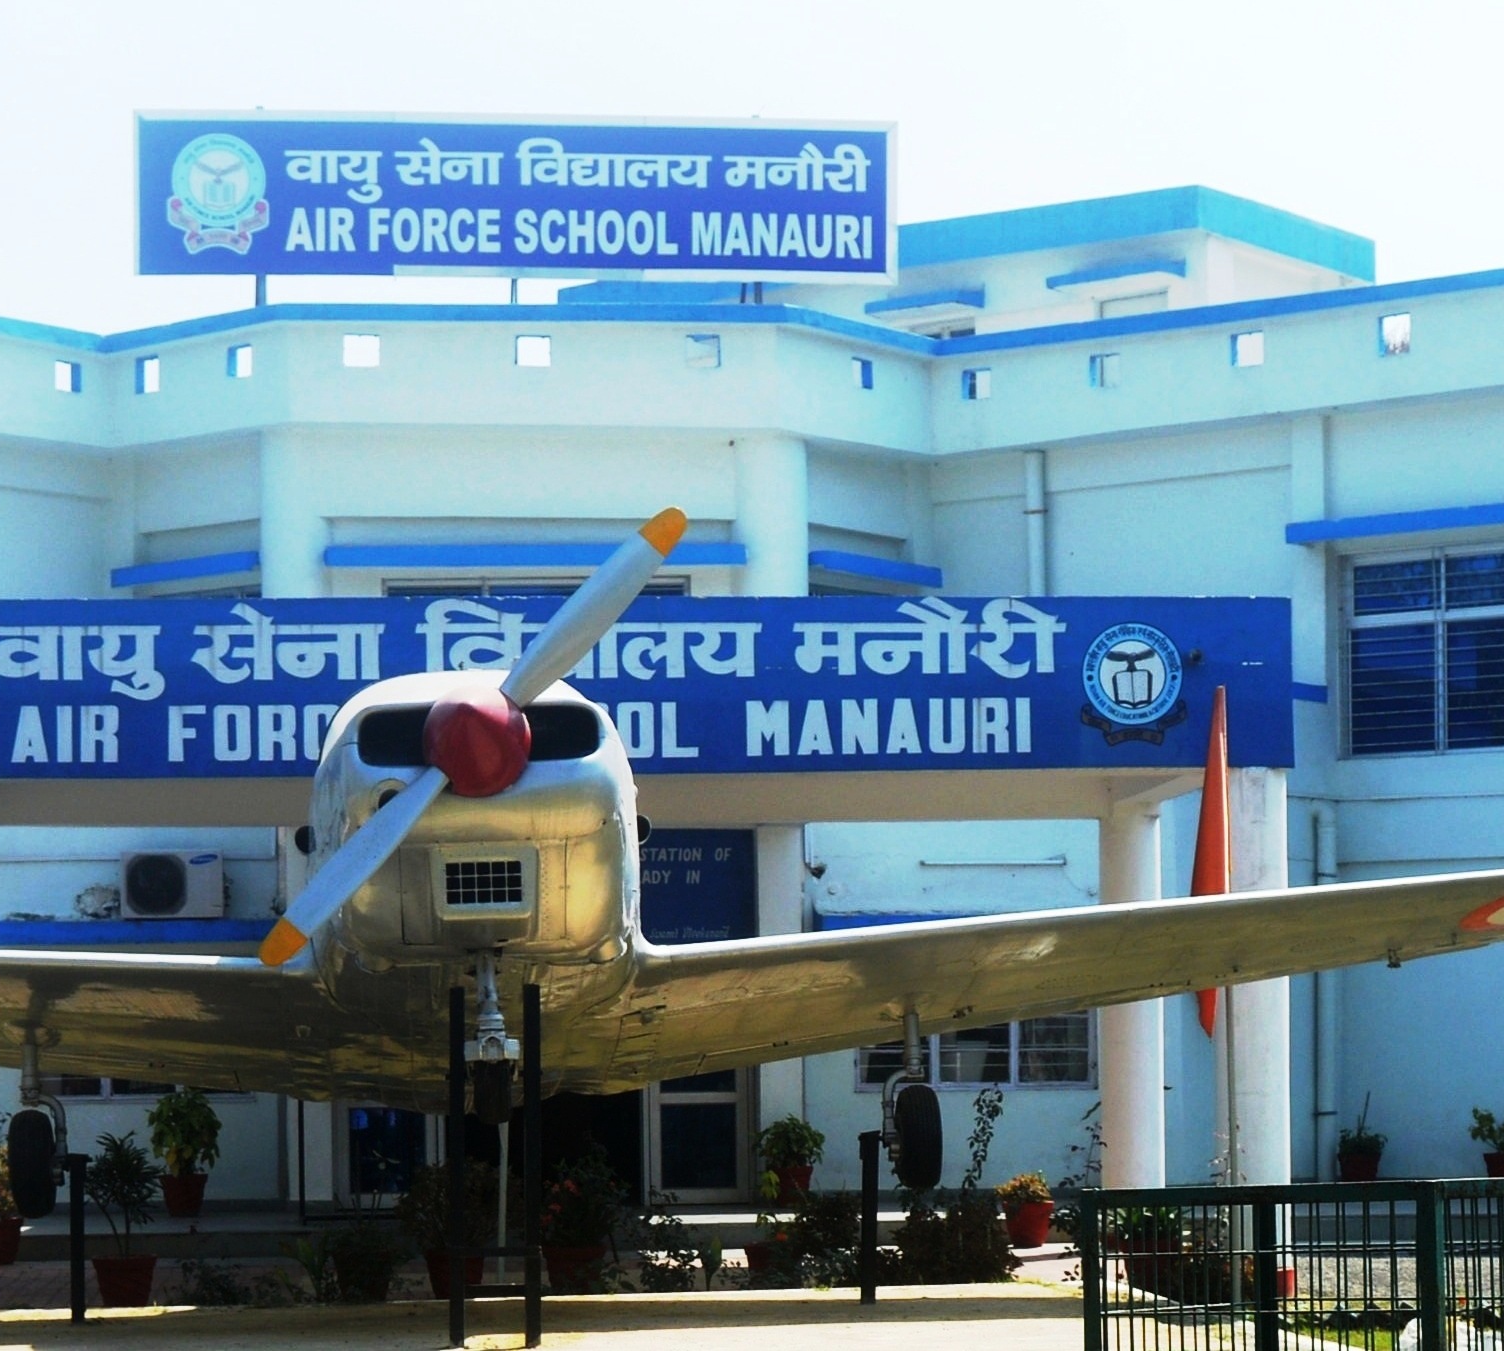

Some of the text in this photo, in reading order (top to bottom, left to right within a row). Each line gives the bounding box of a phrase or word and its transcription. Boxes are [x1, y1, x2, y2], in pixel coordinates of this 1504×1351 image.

[285, 148, 382, 203] वायु
[395, 138, 500, 187] सेना
[516, 137, 708, 190] विद्यालय
[723, 142, 871, 194] मनौरी
[286, 208, 872, 259] AIR FORCE SCHOOL MANAURI
[192, 603, 386, 683] सेना
[415, 599, 762, 680] विालय
[793, 598, 1067, 679] मनौरी
[11, 705, 119, 763] AIR
[168, 704, 340, 762] FORC
[746, 698, 1031, 757] MANAURI
[640, 847, 732, 862] STATION OF
[686, 869, 700, 884] IN
